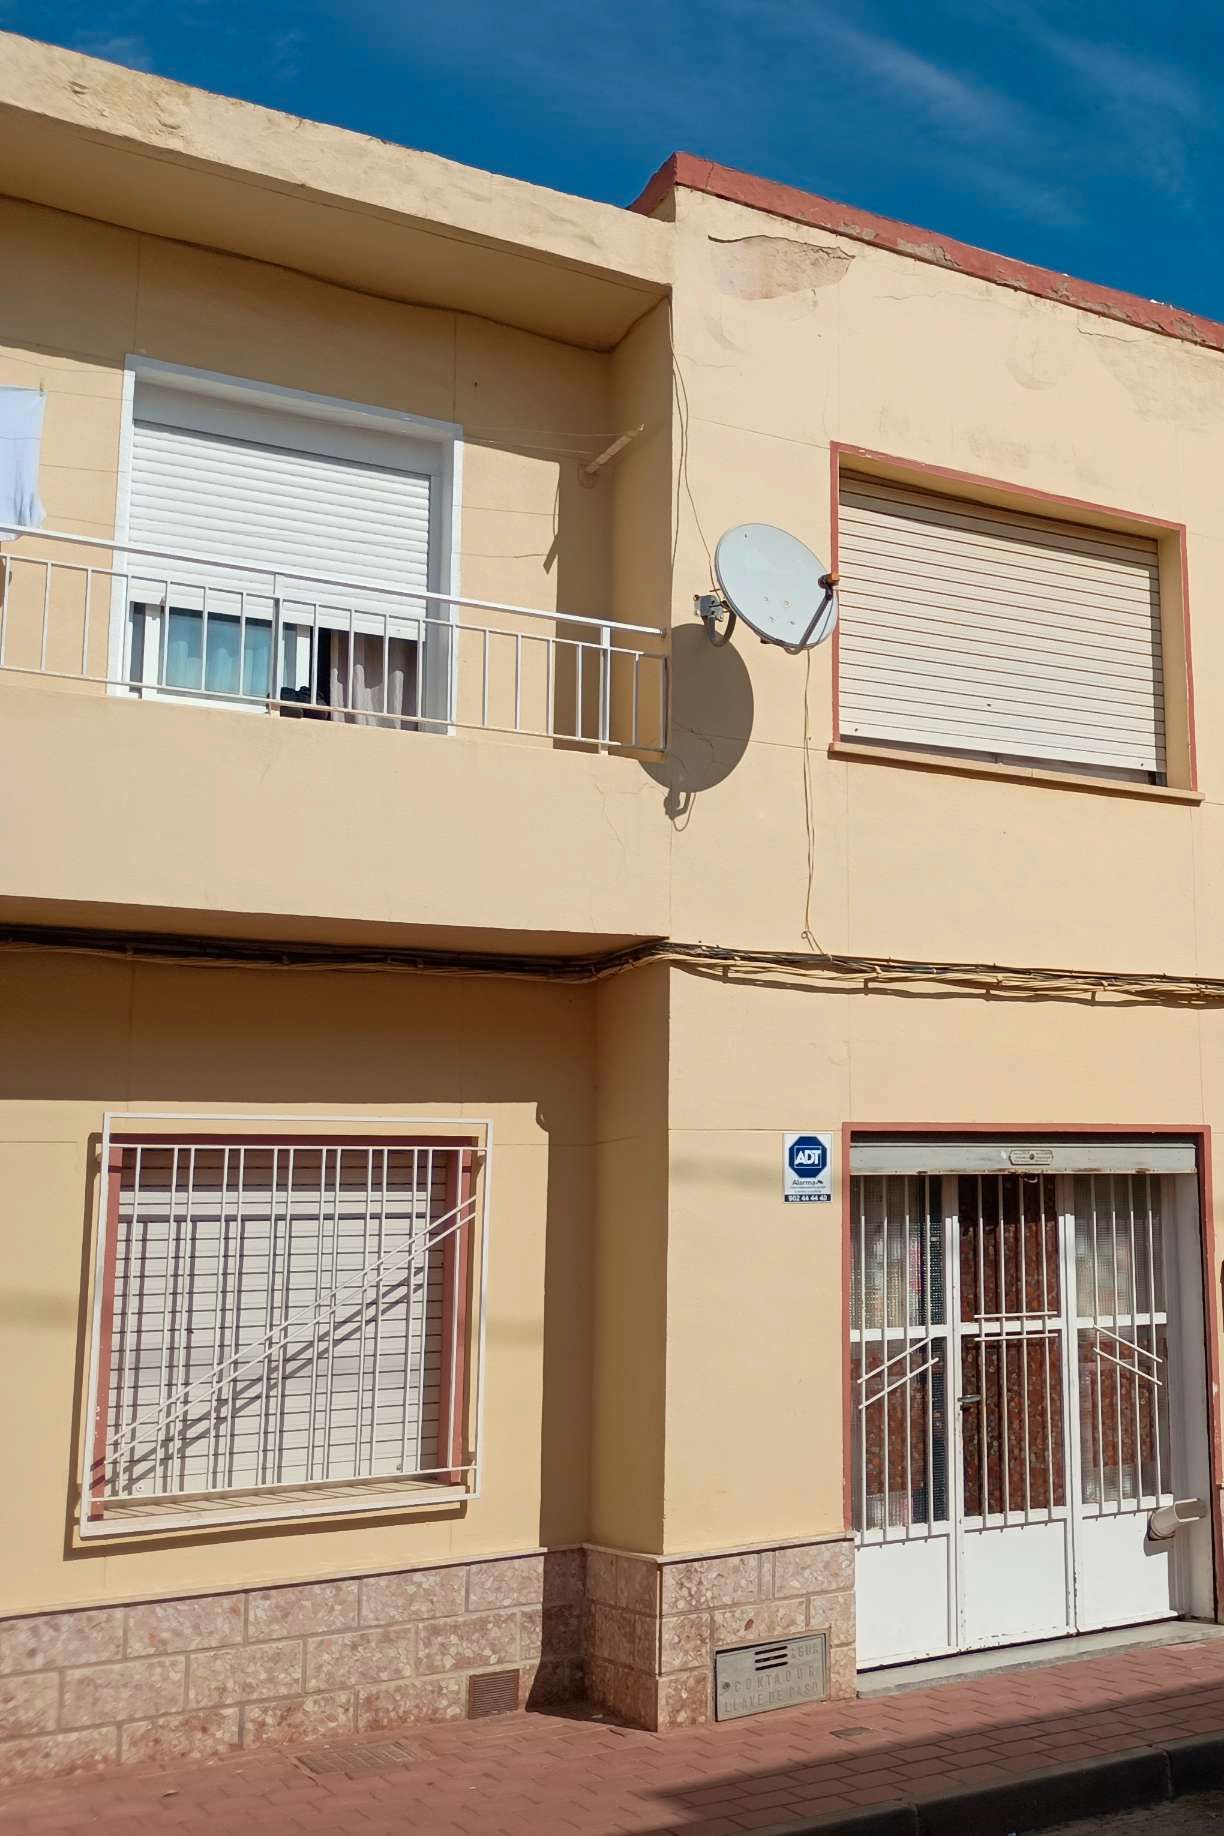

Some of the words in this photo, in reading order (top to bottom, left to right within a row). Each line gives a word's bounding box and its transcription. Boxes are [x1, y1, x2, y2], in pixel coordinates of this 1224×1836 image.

[795, 1149, 821, 1165] ADT
[724, 1694, 763, 1713] LLAVE
[768, 1689, 784, 1704] DE
